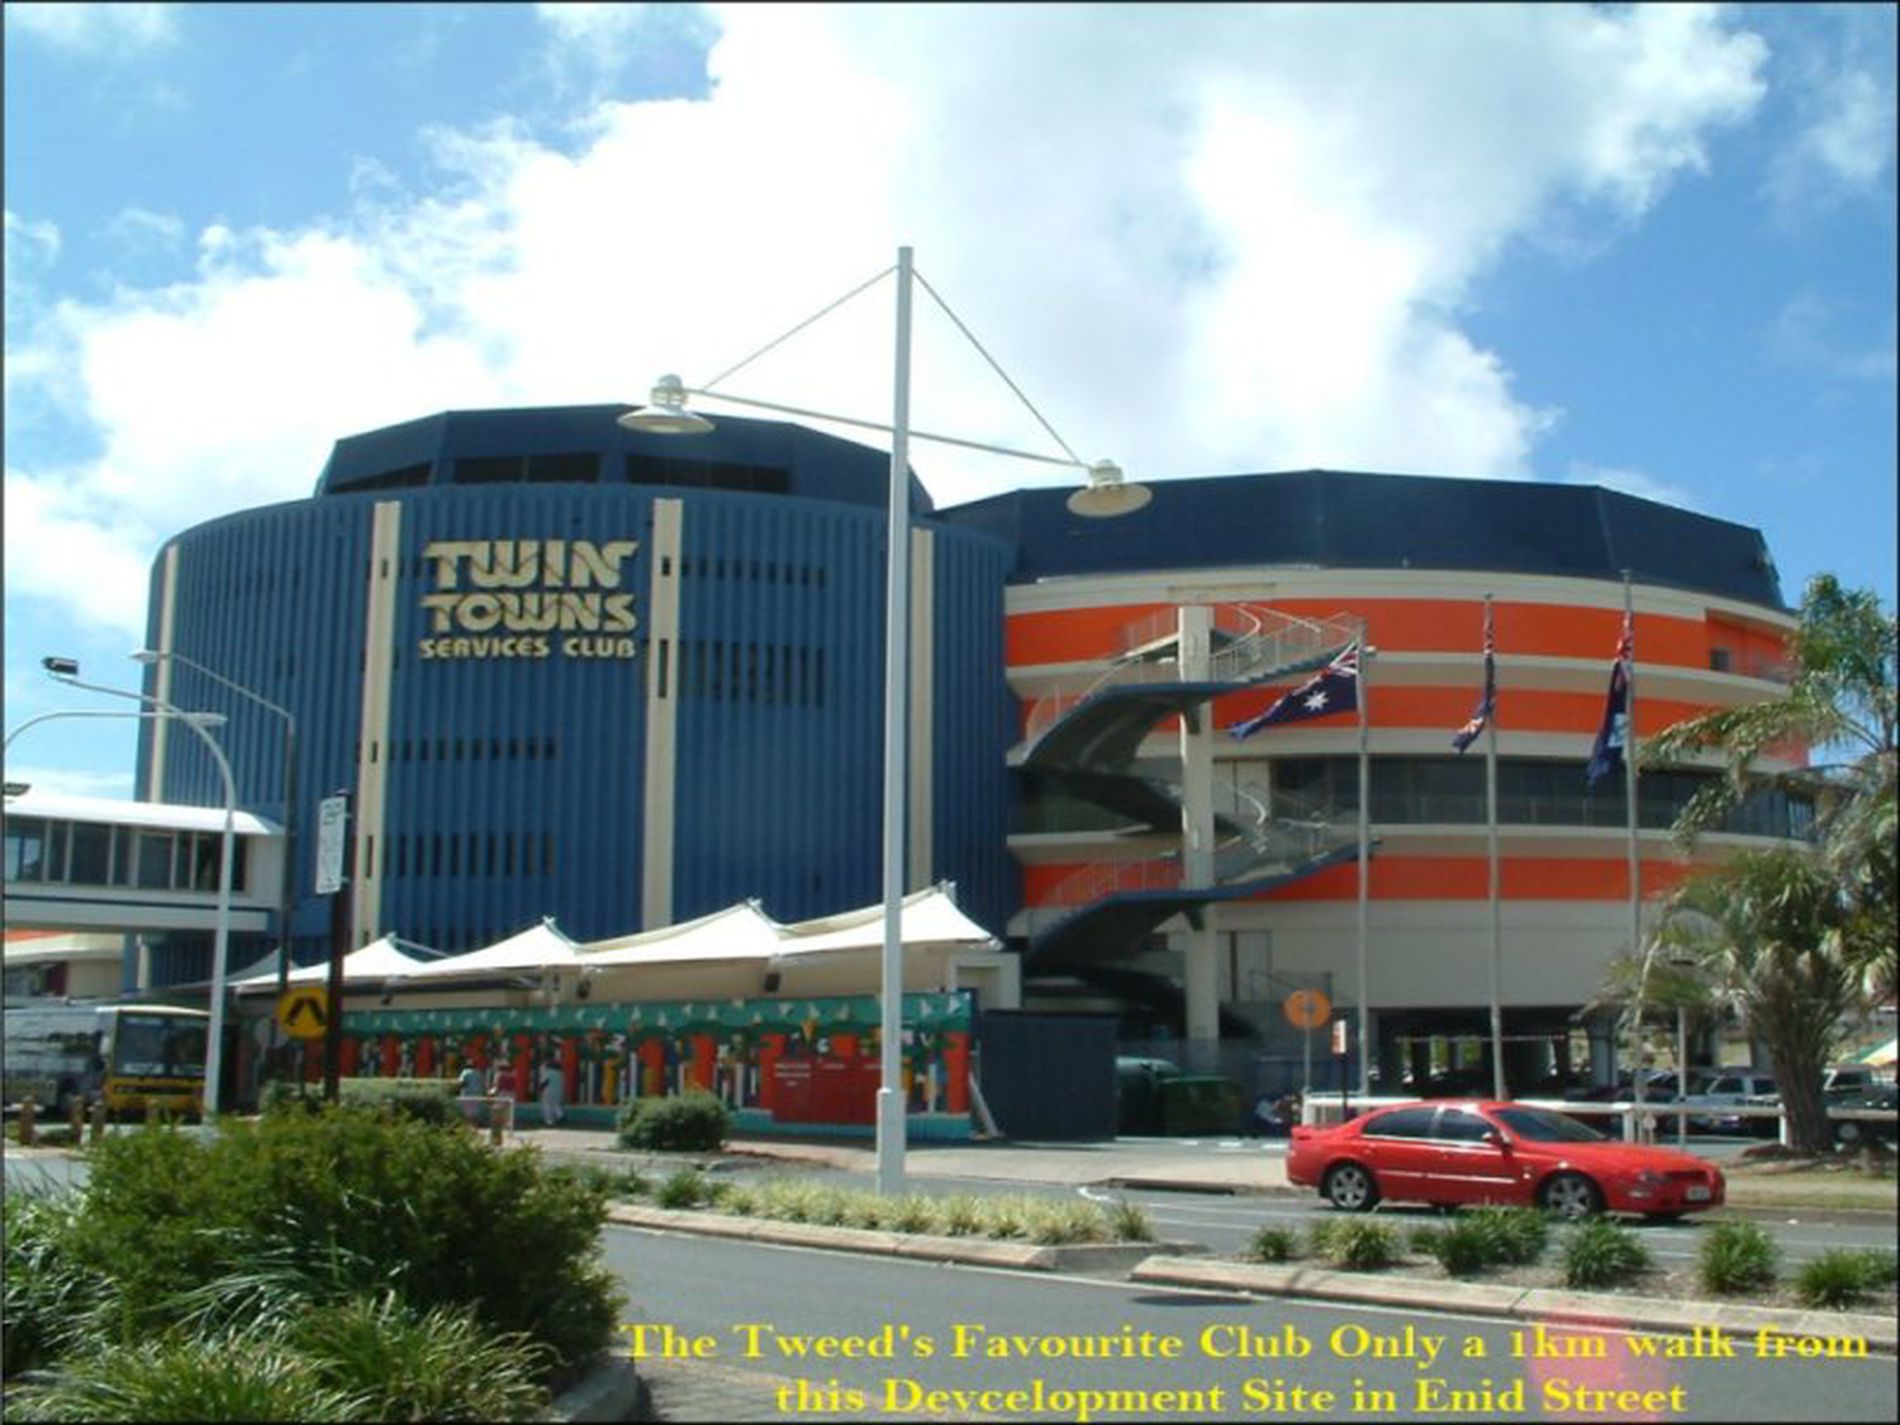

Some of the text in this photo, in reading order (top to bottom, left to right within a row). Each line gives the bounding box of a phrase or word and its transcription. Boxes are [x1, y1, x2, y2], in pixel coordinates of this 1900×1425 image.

[423, 540, 638, 588] TWIN
[421, 592, 637, 632] TOWNS
[419, 637, 636, 659] SERVICES CLUB
